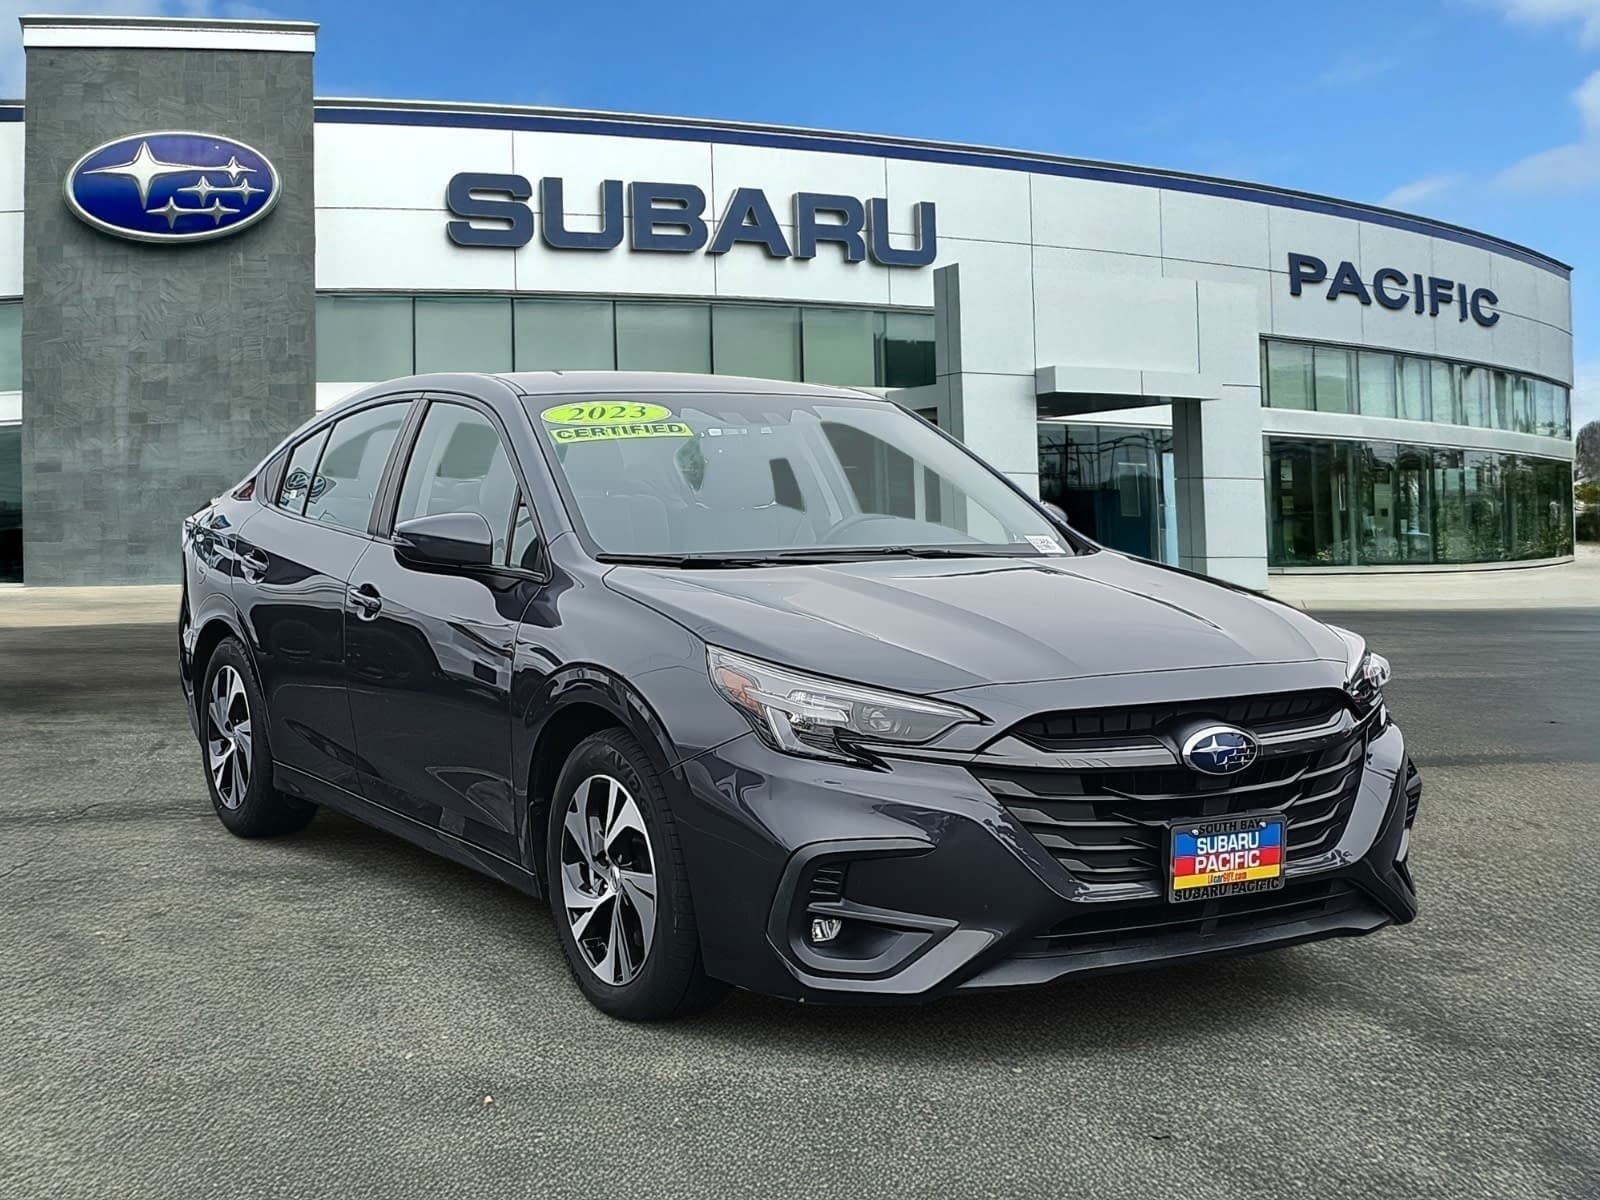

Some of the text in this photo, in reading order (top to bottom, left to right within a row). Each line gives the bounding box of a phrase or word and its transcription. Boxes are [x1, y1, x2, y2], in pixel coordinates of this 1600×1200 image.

[446, 172, 938, 267] SUBARU
[1288, 252, 1500, 327] PACIFIC
[568, 406, 646, 421] 2023
[556, 424, 686, 439] CERTIFIED
[1199, 819, 1261, 834] SOUTH BAY
[1197, 832, 1259, 854] SUBARU
[1195, 850, 1260, 874] PACIFIC
[1174, 879, 1279, 901] SUBARU PACIFIC
